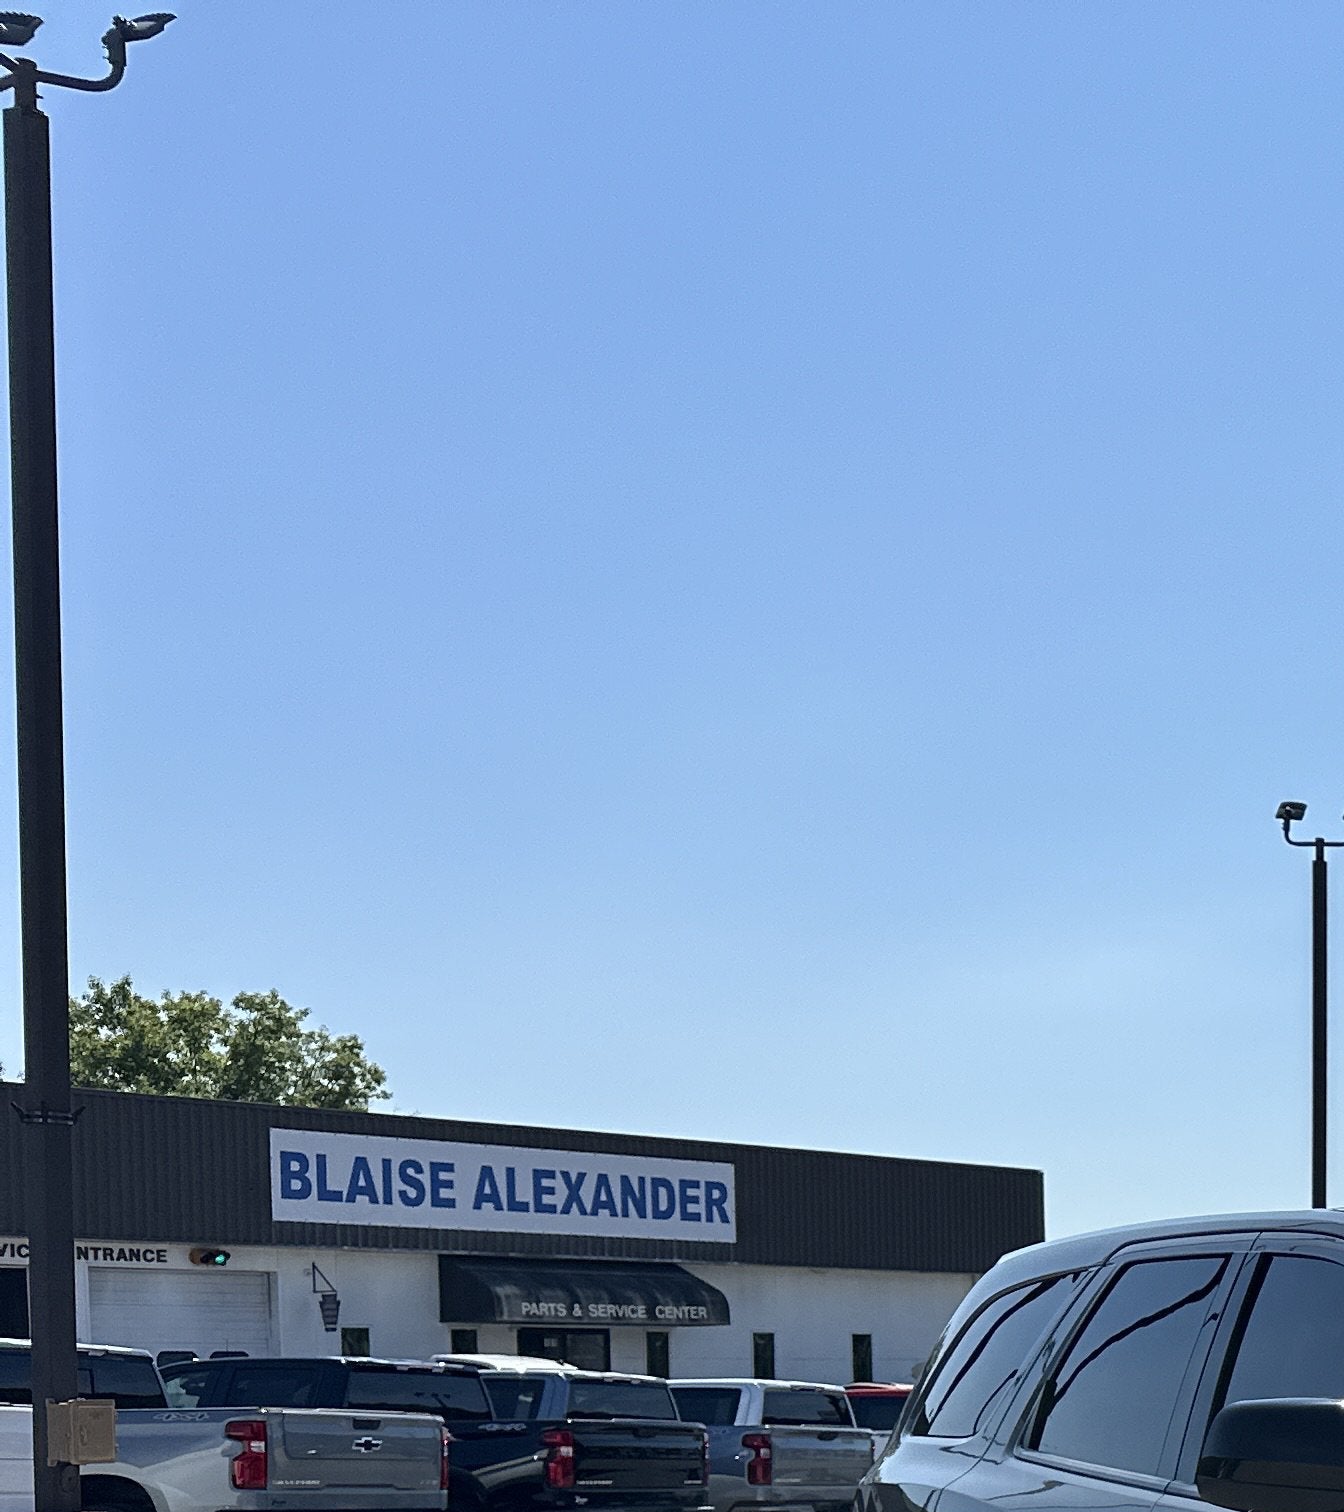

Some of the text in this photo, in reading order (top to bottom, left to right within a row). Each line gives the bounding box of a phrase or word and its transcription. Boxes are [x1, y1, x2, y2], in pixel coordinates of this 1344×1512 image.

[279, 1151, 730, 1224] BLAISE ALEXANDER
[76, 1246, 168, 1263] NTRANCE
[521, 1302, 708, 1320] PARTS & SERVICE CENTER
